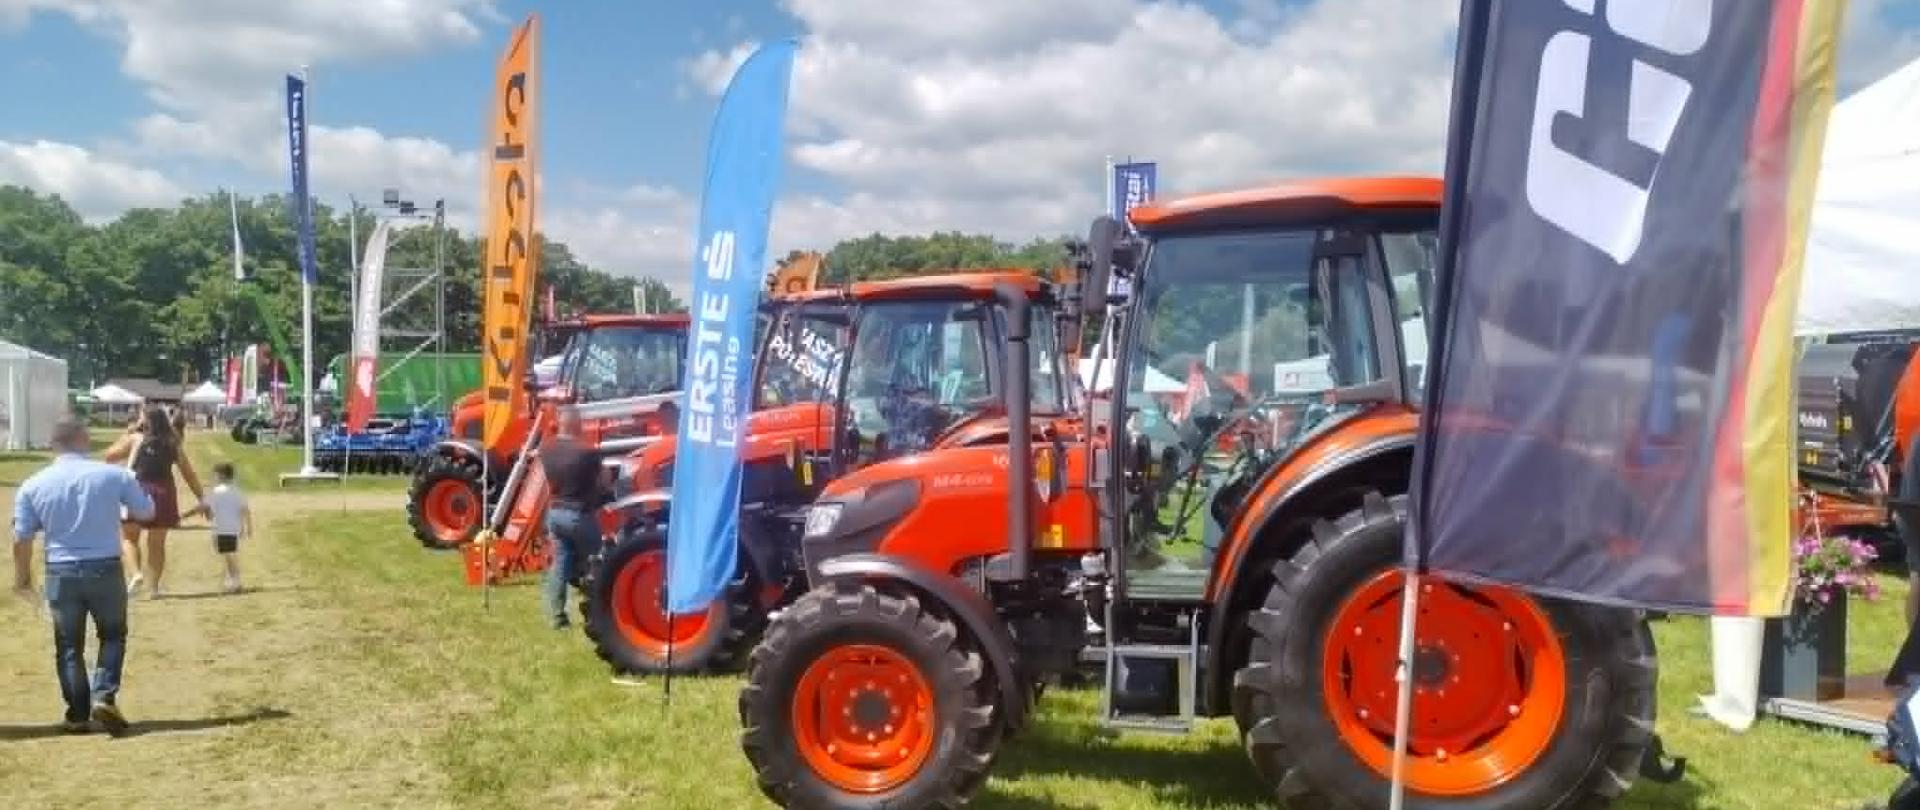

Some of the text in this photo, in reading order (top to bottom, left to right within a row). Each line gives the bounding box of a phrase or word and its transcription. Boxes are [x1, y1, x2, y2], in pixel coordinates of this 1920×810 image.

[486, 72, 526, 402] Kubota
[690, 290, 729, 443] ERSTE
[716, 336, 740, 447] Leasing
